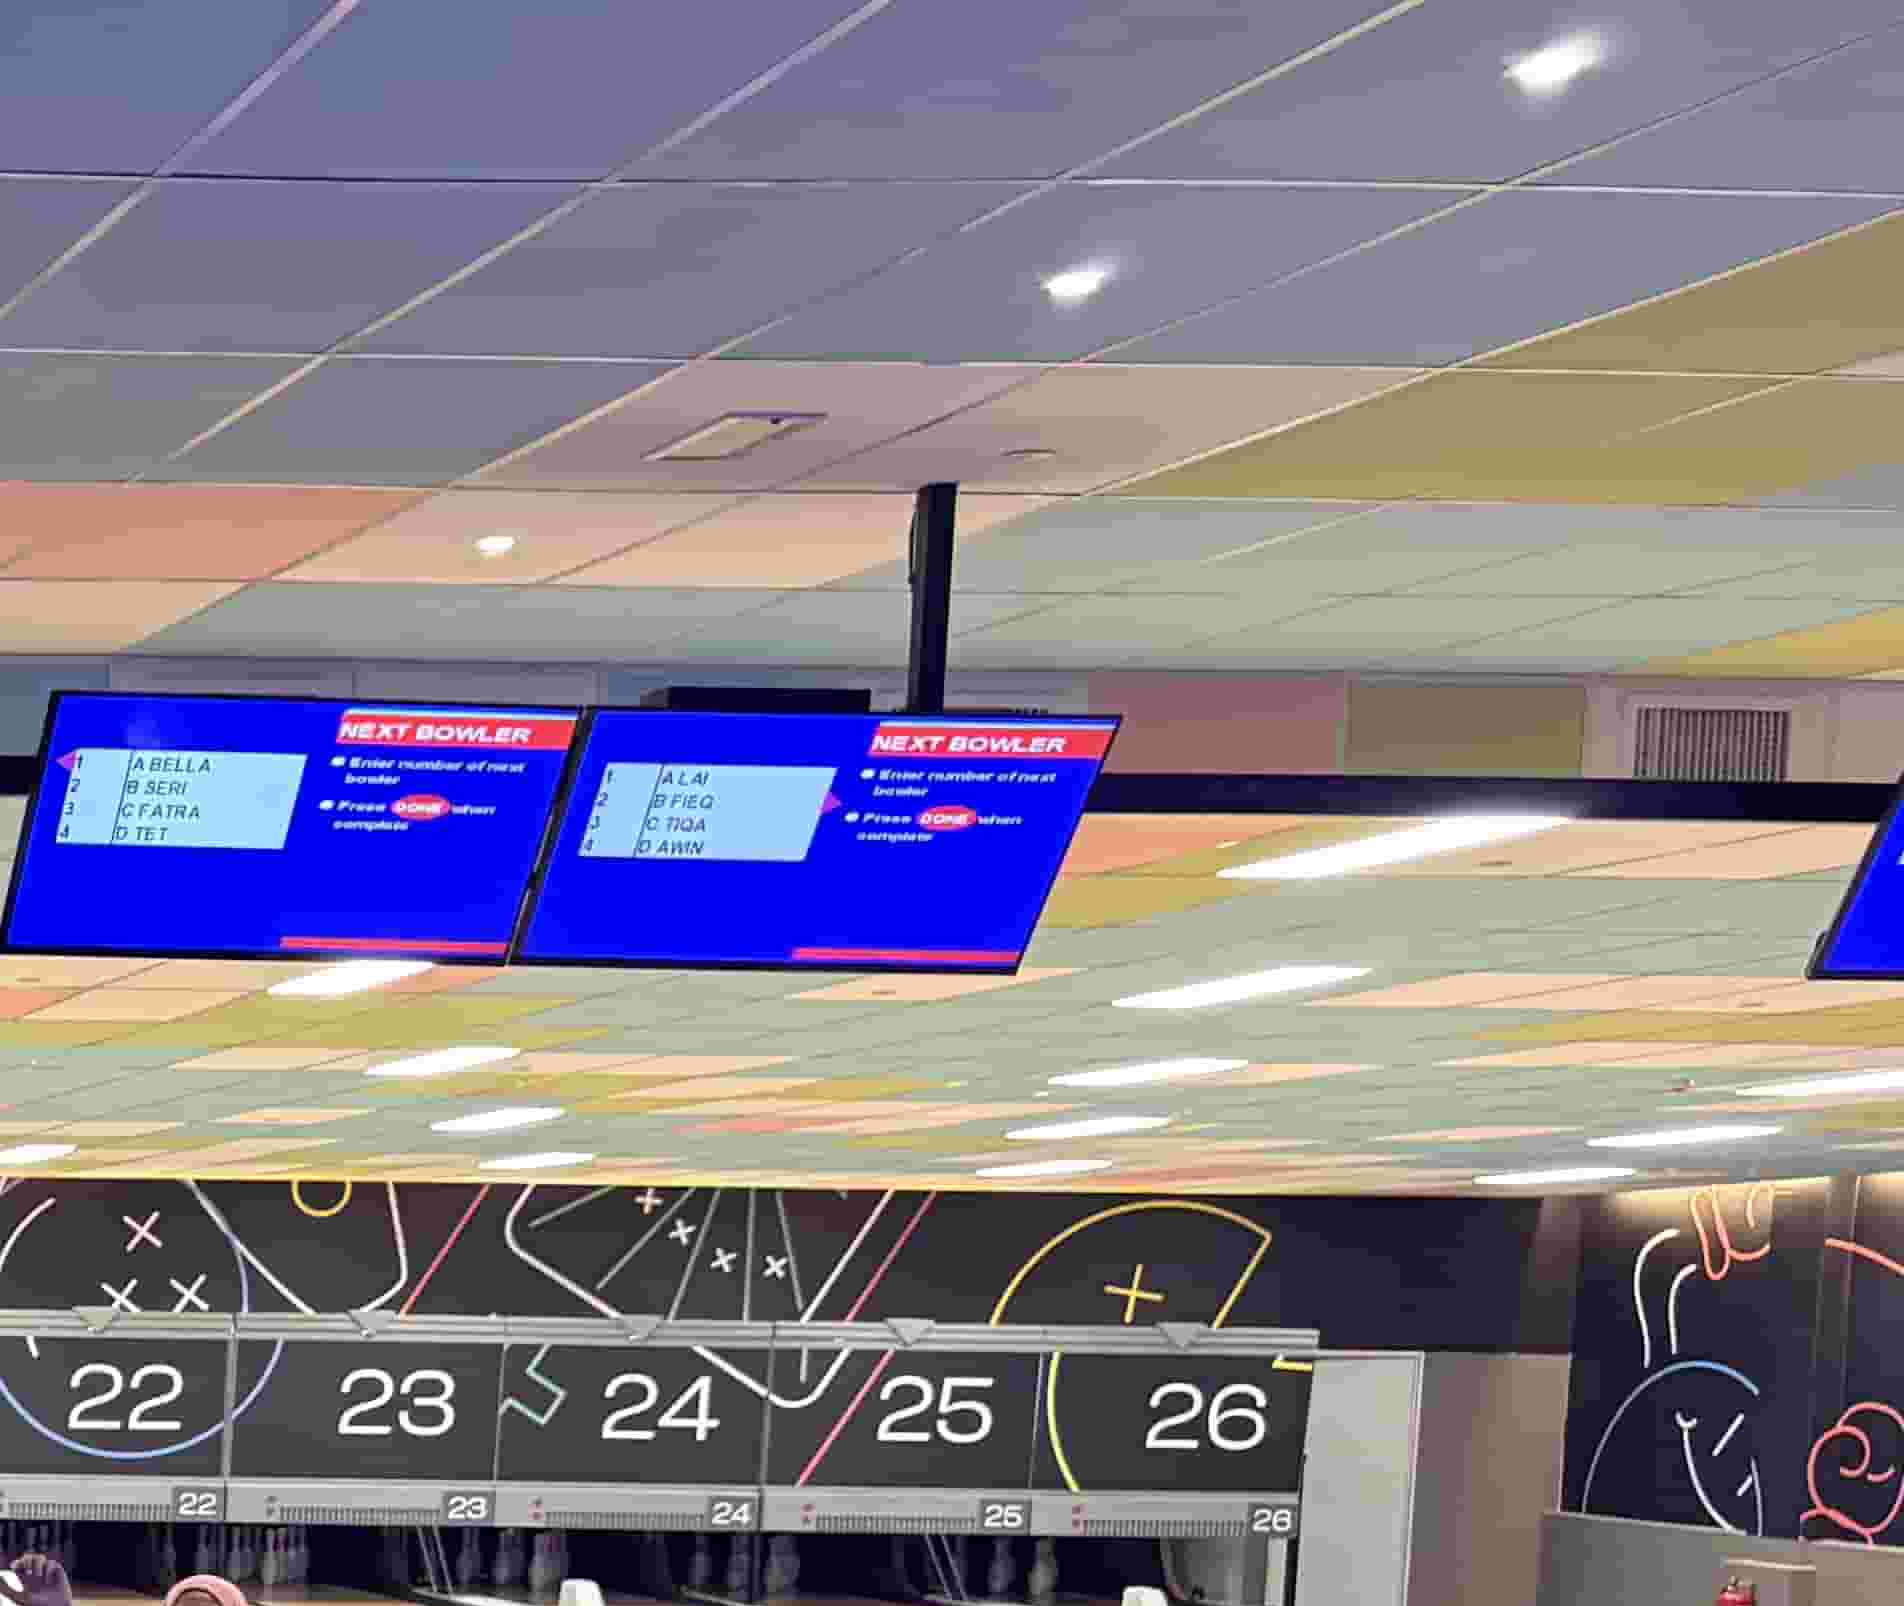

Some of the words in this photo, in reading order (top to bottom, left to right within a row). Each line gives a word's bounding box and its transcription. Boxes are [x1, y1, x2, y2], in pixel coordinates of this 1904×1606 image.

[339, 723, 412, 741] NEXT
[415, 724, 532, 743] BOWLER
[872, 735, 946, 752] NEXT
[948, 736, 1066, 753] BOWLER
[149, 757, 211, 773] BELLA
[144, 780, 187, 796] SERI
[68, 1365, 183, 1430] 22
[338, 1369, 455, 1436] 23
[602, 1375, 720, 1441] 24
[877, 1376, 994, 1444] 25
[1145, 1382, 1266, 1451] 26
[179, 1493, 216, 1515] 22
[447, 1499, 487, 1520] 23
[712, 1503, 751, 1526] 24
[985, 1506, 1023, 1529] 25
[1253, 1509, 1291, 1532] 26
